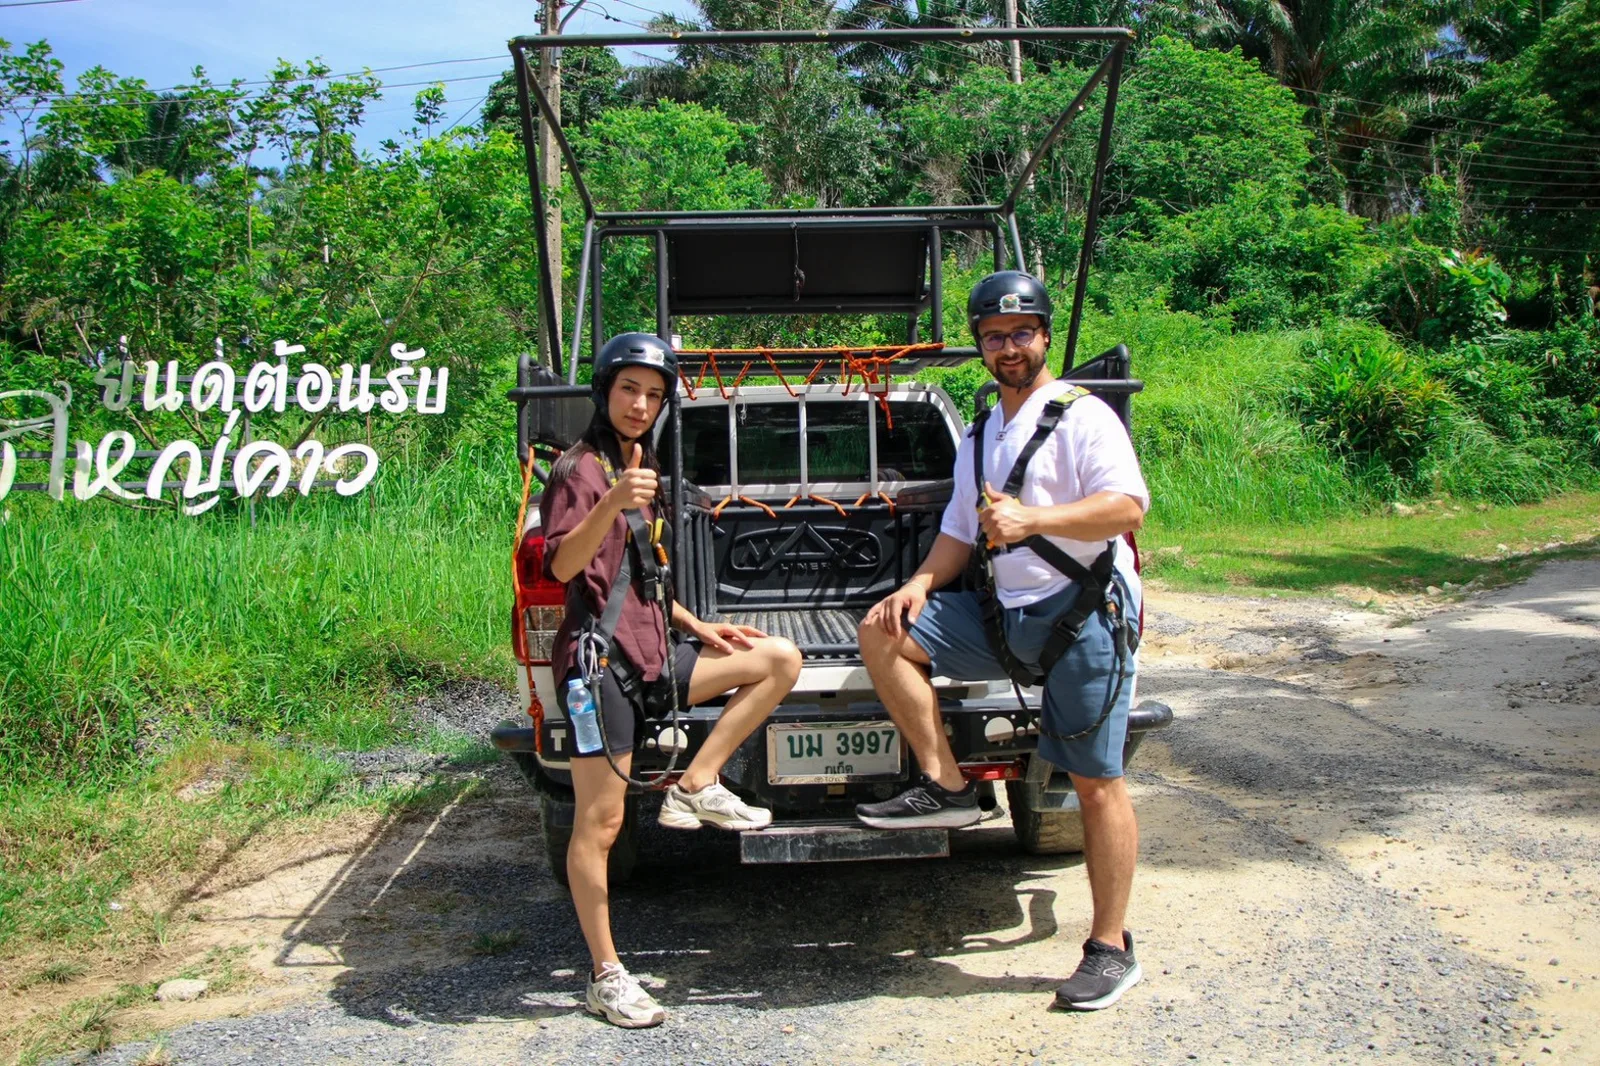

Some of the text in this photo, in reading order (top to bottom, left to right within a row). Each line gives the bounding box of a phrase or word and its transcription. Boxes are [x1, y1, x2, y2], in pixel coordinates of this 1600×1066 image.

[787, 730, 895, 759] บม 3997
[824, 761, 854, 775] ภเก็ต
